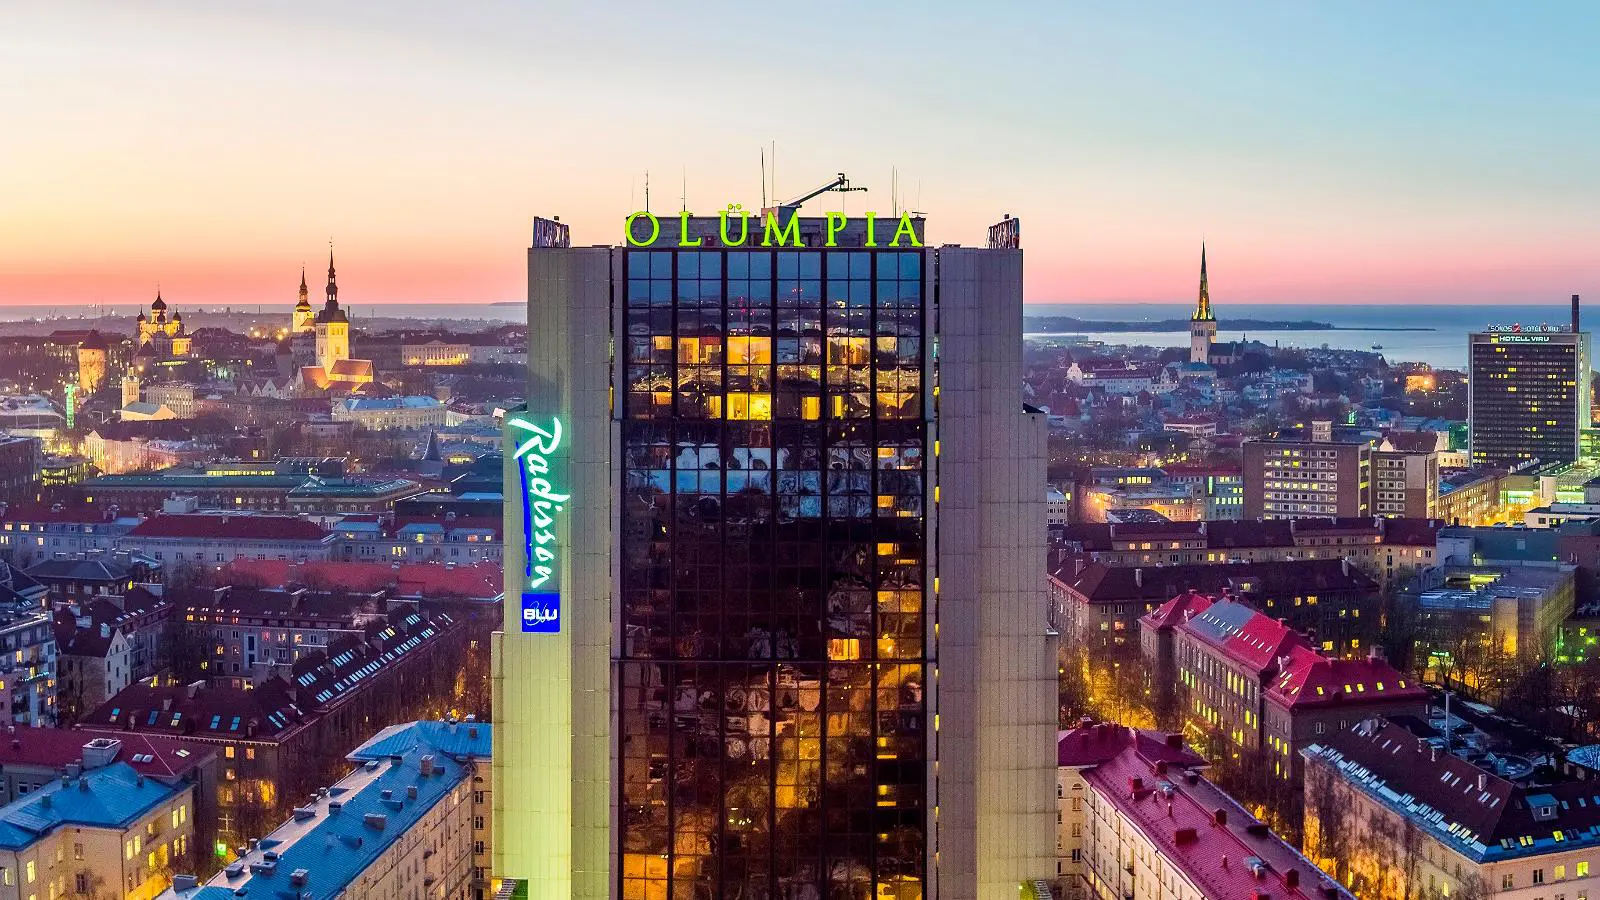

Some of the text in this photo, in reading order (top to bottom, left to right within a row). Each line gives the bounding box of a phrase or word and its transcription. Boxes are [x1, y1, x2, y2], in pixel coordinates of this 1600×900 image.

[625, 203, 924, 247] OLÜMPIA
[508, 416, 571, 588] Radisson
[523, 608, 558, 621] BLU
